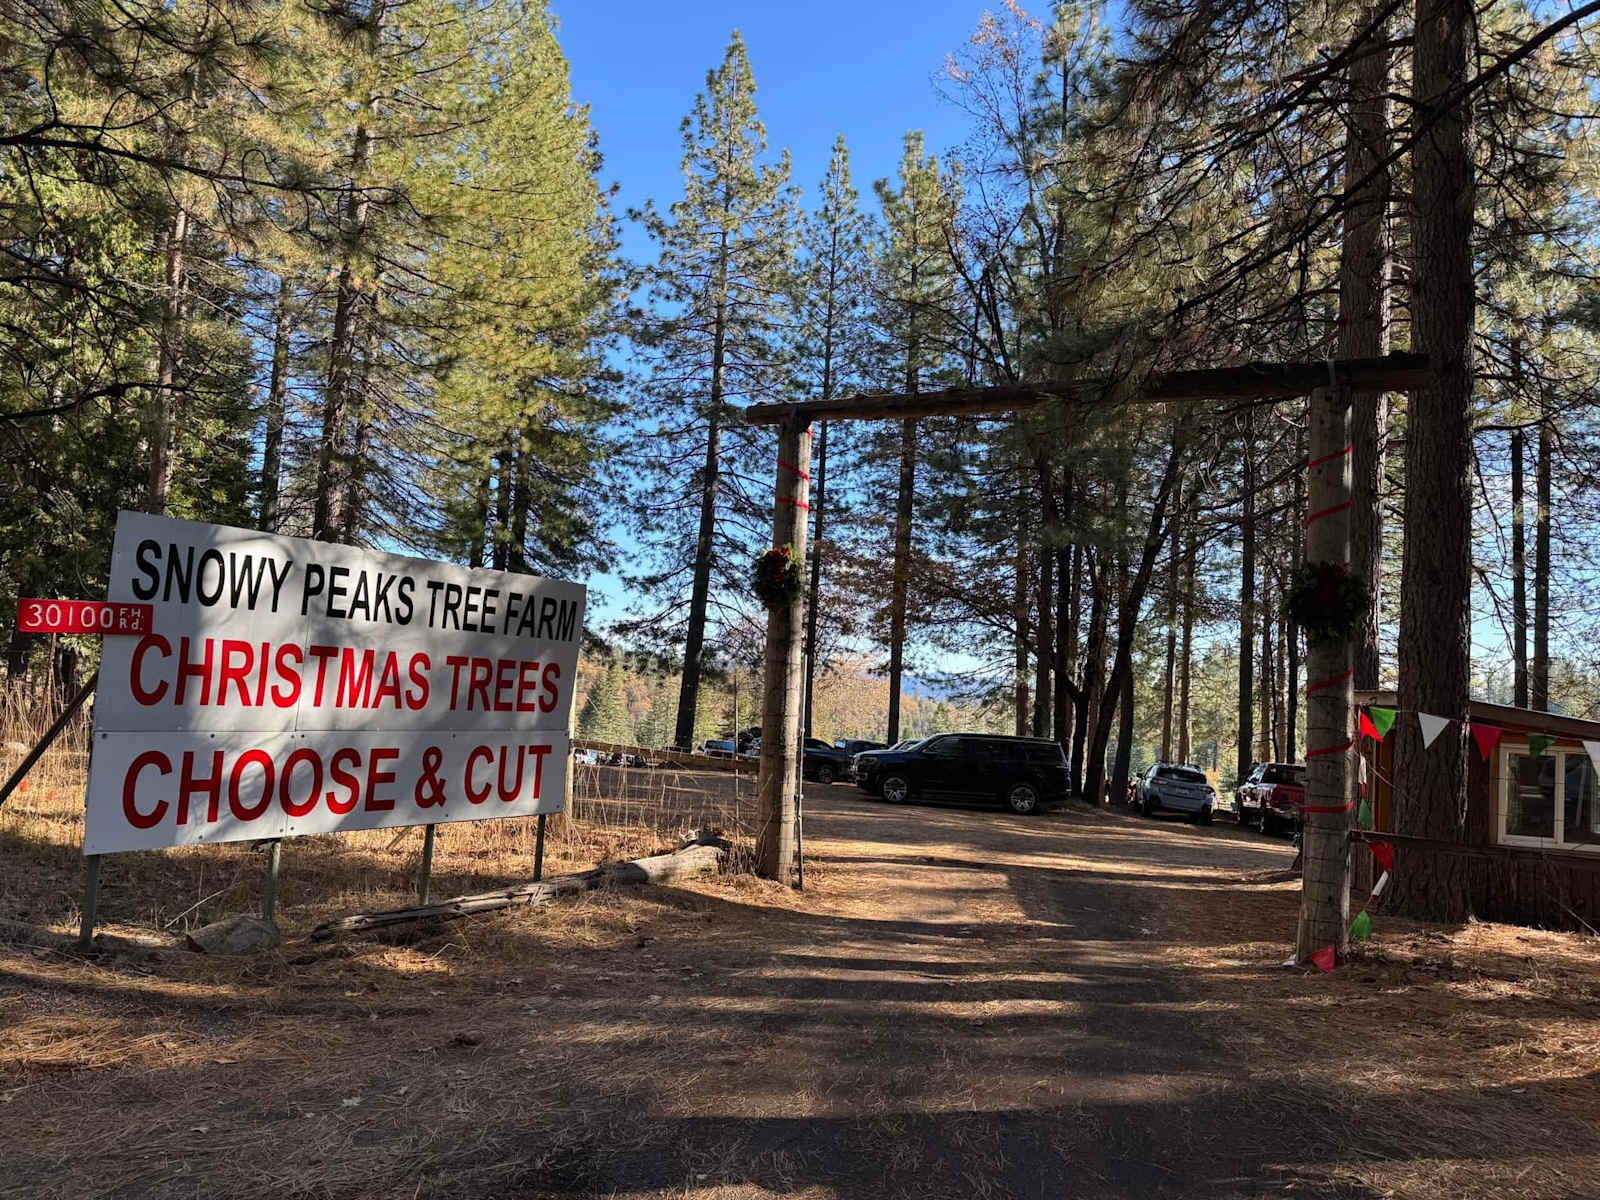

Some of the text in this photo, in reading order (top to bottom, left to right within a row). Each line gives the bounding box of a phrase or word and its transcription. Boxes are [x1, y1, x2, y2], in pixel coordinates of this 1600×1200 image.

[25, 604, 114, 628] 30100
[119, 607, 144, 618] F.H.
[132, 539, 577, 642] SNOWY PEAKS TREE FARM
[119, 618, 143, 631] Rd.
[130, 634, 560, 713] CHRISTMAS TREES
[122, 745, 552, 829] CHOOSE & CUT
